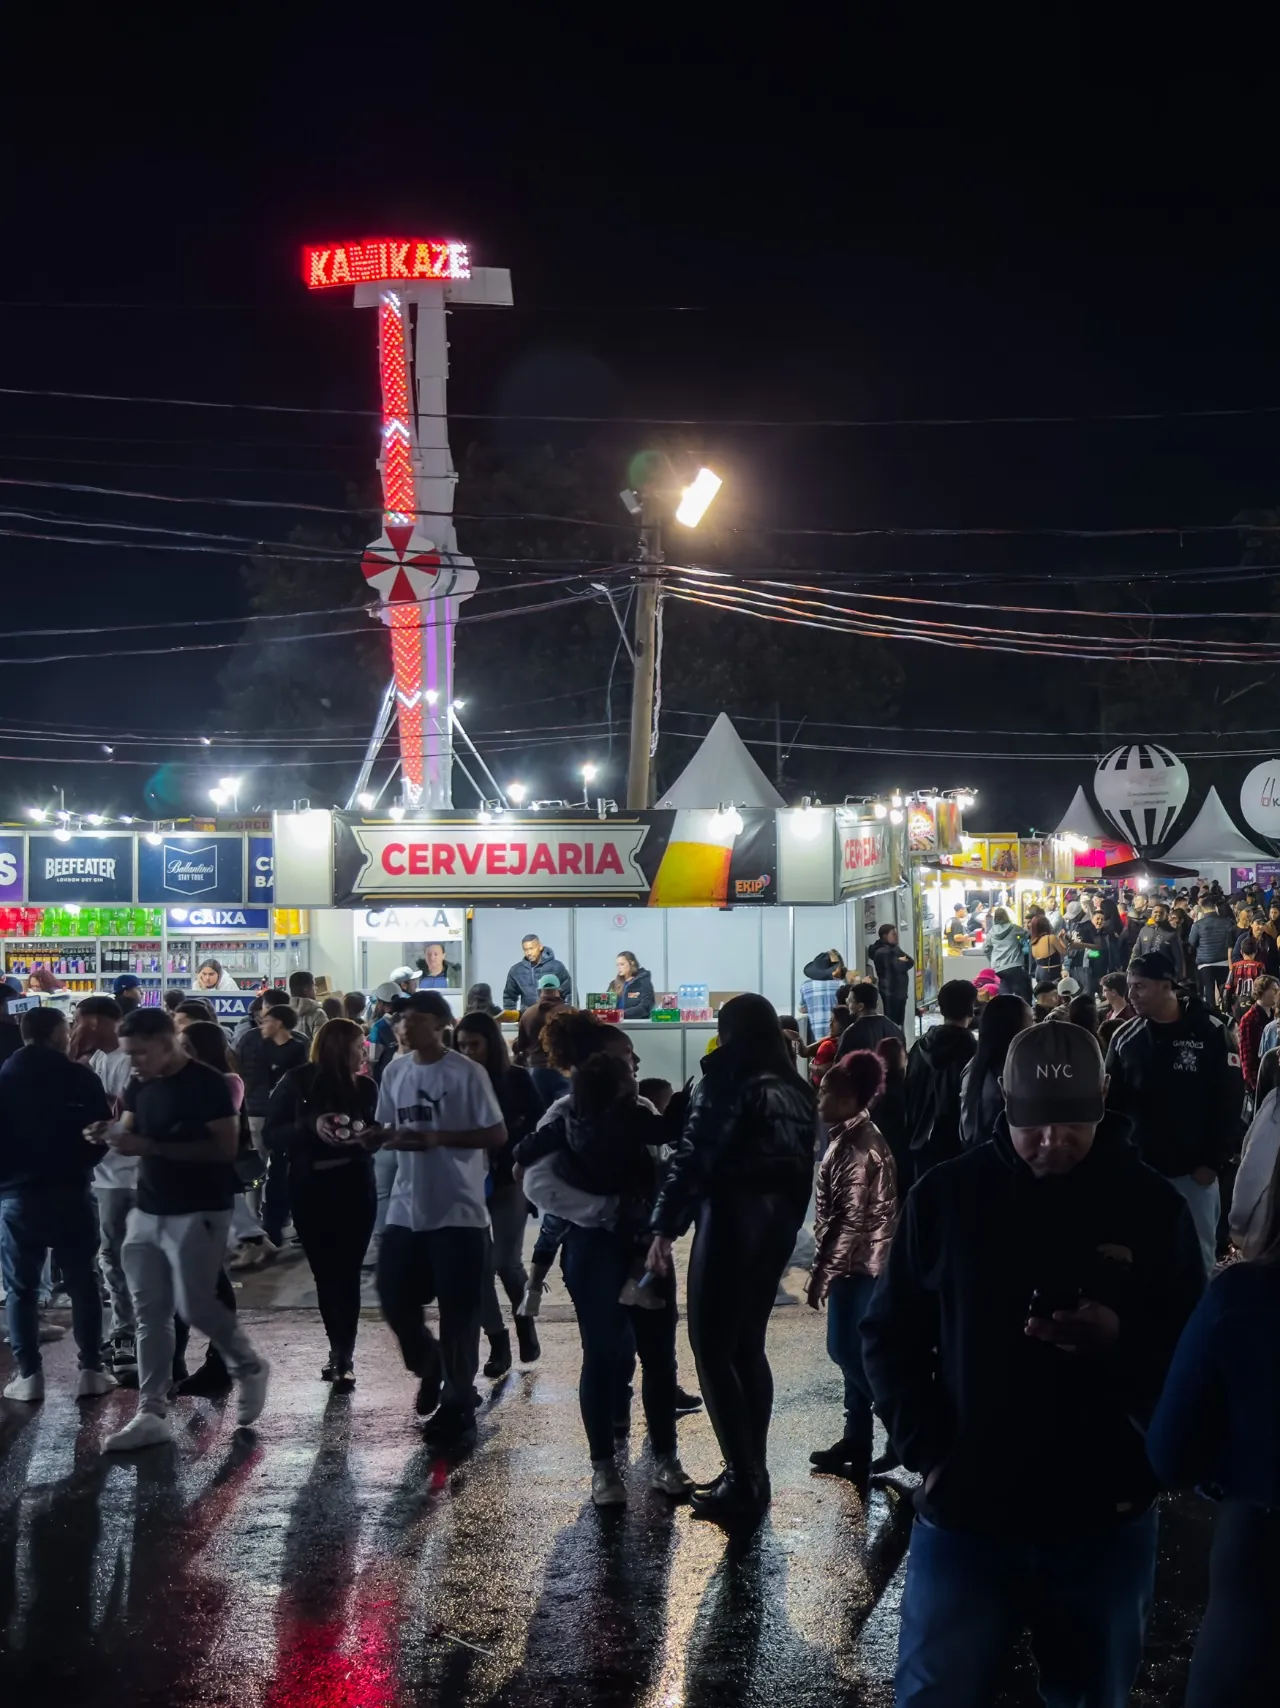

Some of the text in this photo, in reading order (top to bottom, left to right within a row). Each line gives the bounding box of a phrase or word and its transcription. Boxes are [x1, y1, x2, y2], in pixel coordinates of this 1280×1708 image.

[381, 842, 625, 875] CERVEJARIA
[45, 858, 116, 880] BEEFEATER
[167, 860, 214, 874] Ballantine's
[189, 910, 247, 925] CAIXA
[215, 999, 247, 1012] IXA
[1037, 1064, 1073, 1079] NYC
